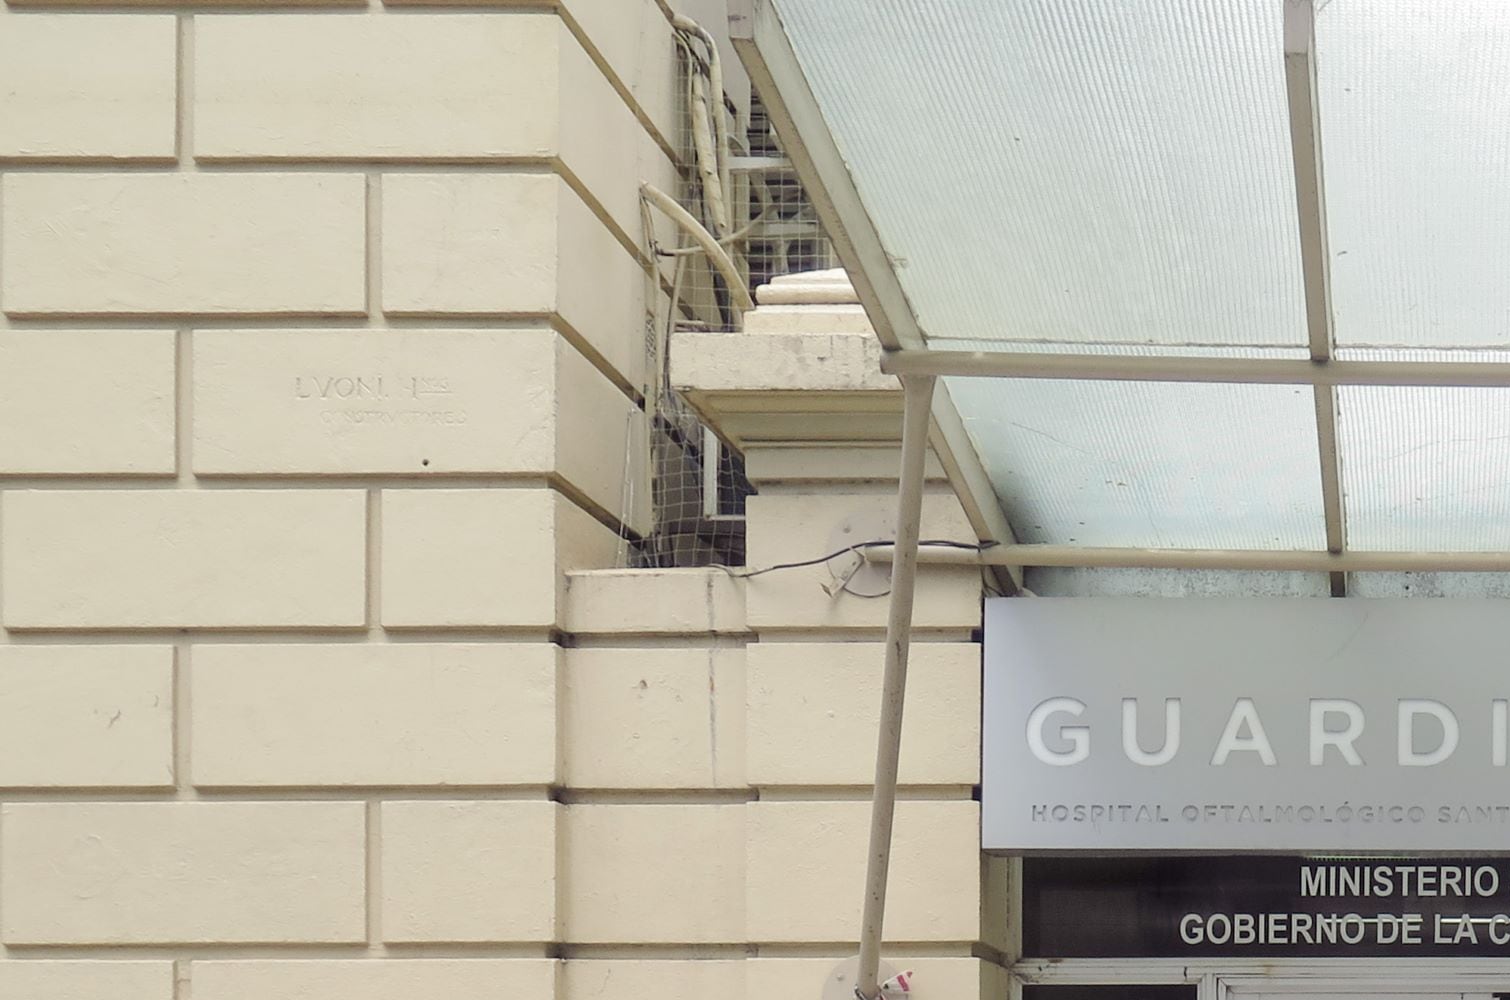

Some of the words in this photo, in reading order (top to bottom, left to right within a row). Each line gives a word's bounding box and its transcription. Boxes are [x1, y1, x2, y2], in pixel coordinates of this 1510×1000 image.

[1032, 804, 1169, 822] HOSPITAL
[1182, 801, 1425, 823] OFTALMOLÓGICO
[1300, 866, 1500, 898] MINISTERIO
[1180, 913, 1366, 945] GOBIERNO
[1377, 914, 1423, 944] DE
[1434, 914, 1478, 944] LA
